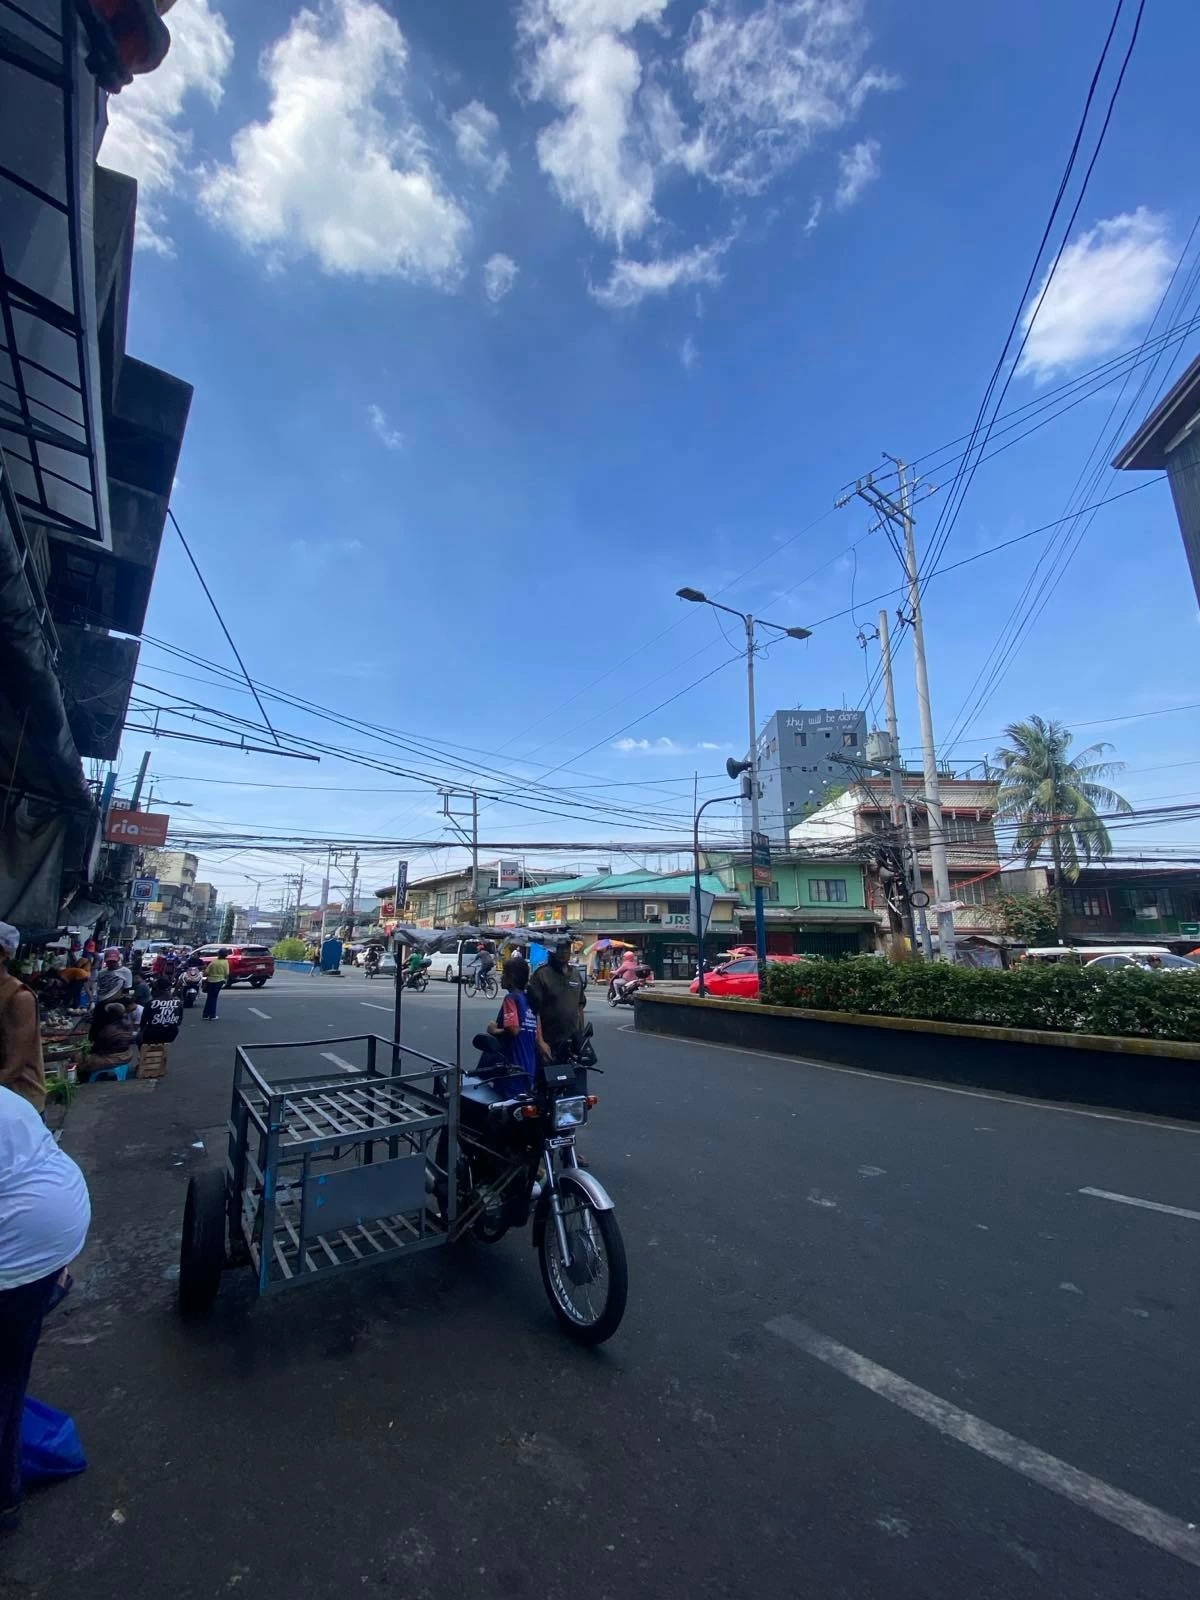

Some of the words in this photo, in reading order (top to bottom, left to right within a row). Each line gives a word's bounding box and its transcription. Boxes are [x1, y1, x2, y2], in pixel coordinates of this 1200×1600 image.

[786, 716, 804, 731] thy
[808, 713, 822, 725] will
[826, 713, 835, 723] be
[838, 712, 859, 721] done
[111, 819, 139, 835] ria
